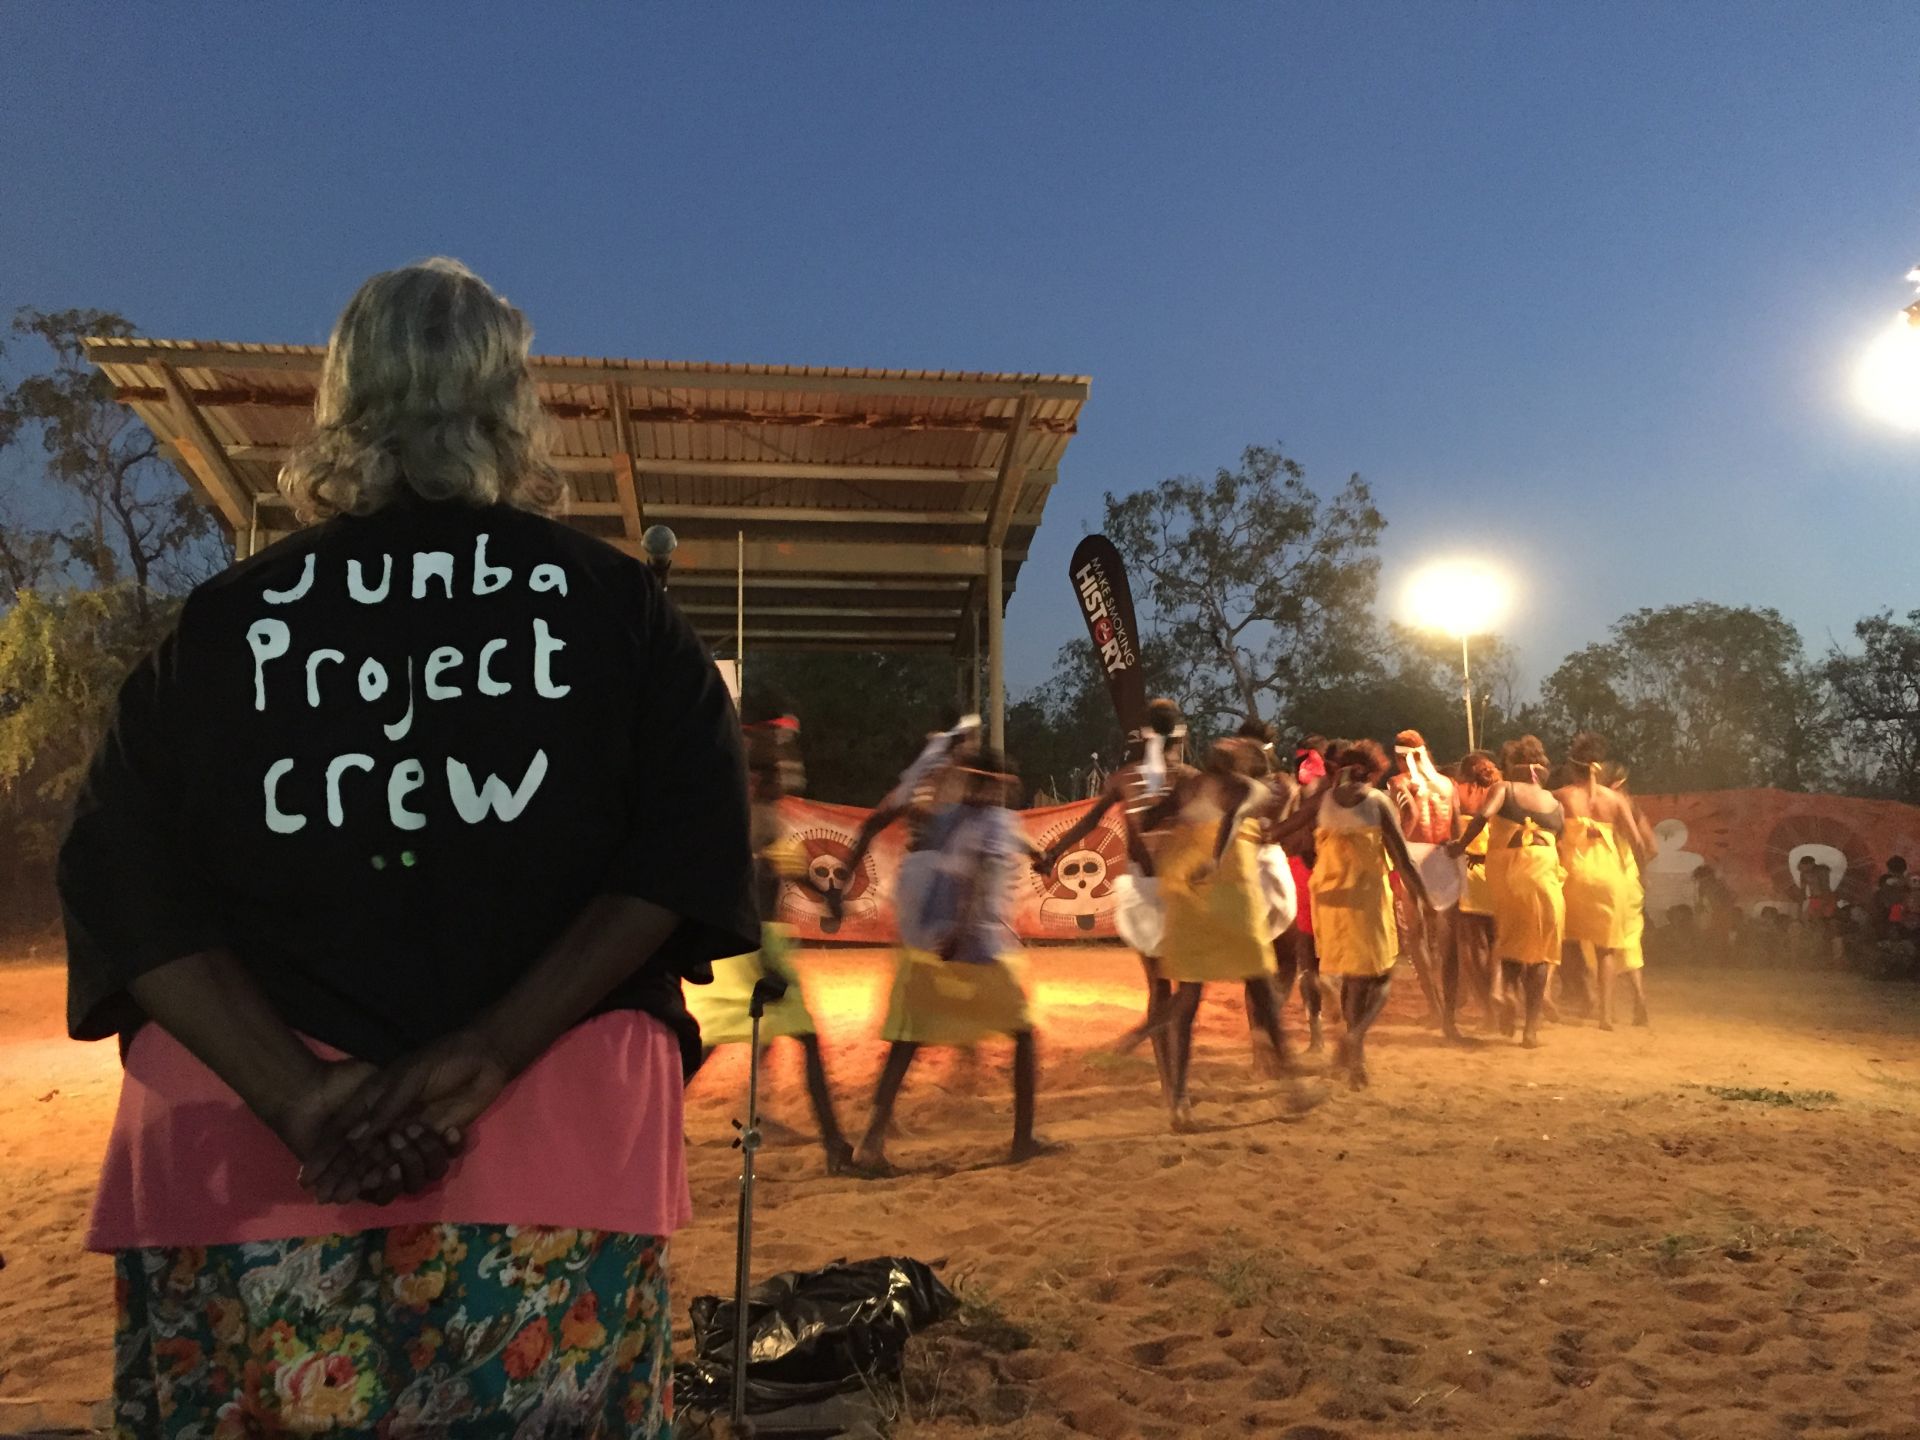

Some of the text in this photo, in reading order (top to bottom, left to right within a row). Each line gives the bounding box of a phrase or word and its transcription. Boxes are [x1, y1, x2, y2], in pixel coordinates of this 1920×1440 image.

[262, 533, 568, 604] Junba
[1091, 556, 1135, 666] MAKE SMOKING
[246, 618, 571, 741] Project
